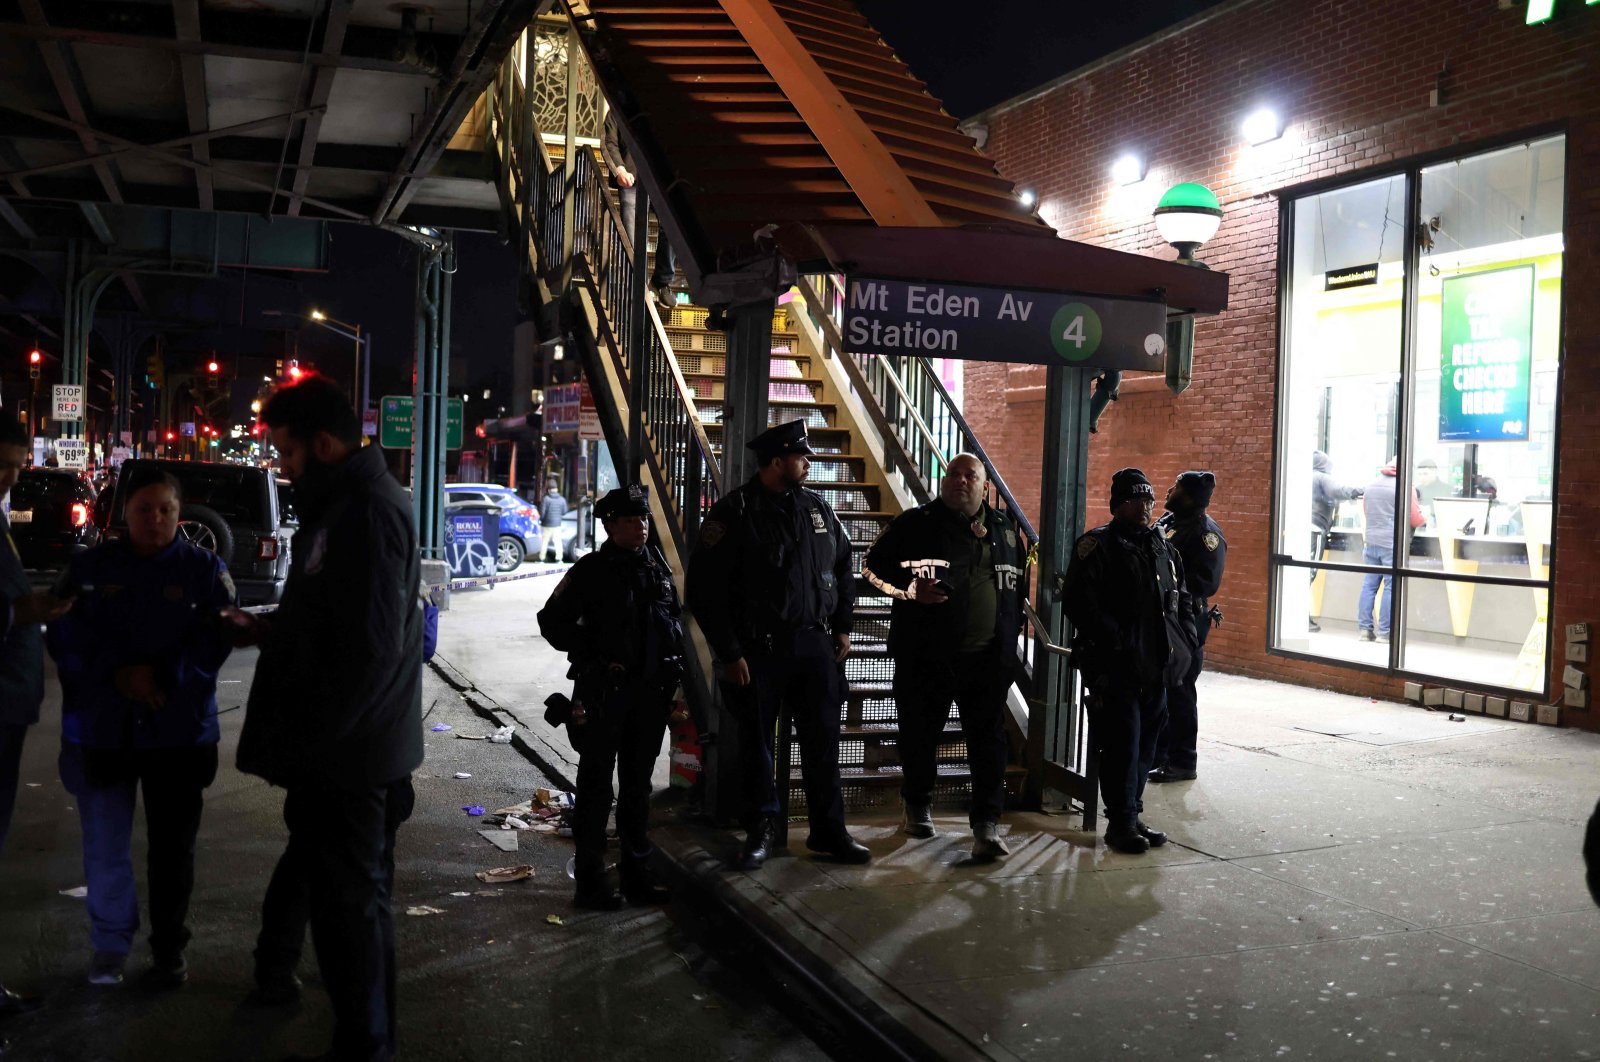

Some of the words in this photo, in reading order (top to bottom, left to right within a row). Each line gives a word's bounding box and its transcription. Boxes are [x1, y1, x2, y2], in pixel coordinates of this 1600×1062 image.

[850, 281, 889, 312] Mt
[907, 286, 980, 318] Eden
[997, 293, 1034, 322] Av
[848, 316, 959, 351] Station
[1062, 315, 1087, 349] 4
[1452, 339, 1519, 366] REFUND
[1453, 364, 1516, 391] CHECKS
[55, 387, 81, 396] STOP
[1462, 390, 1504, 415] HERE
[58, 403, 77, 412] RED
[386, 415, 408, 423] Cross
[395, 425, 411, 433] New
[59, 440, 78, 448] WINDOWS
